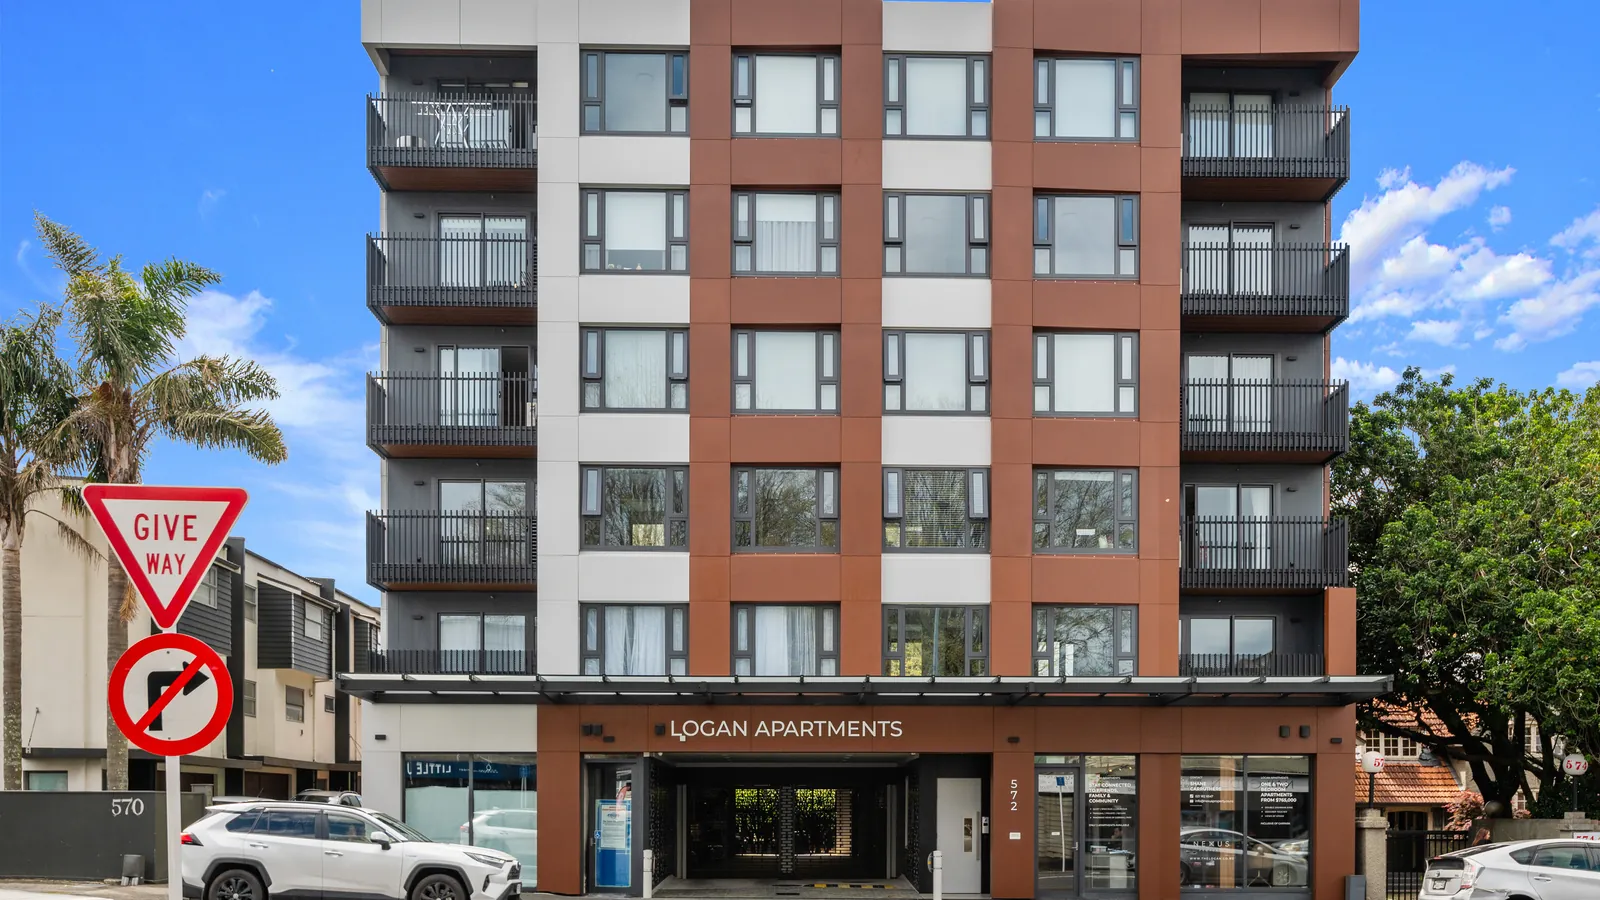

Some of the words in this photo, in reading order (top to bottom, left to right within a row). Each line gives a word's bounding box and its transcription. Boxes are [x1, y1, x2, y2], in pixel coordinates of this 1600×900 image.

[134, 513, 197, 541] GIVE
[146, 553, 186, 575] WAY
[670, 720, 748, 737] LOGAN
[754, 720, 903, 737] APARTMENTS
[1566, 760, 1587, 770] 574
[1010, 779, 1018, 811] 572
[111, 797, 145, 817] 570
